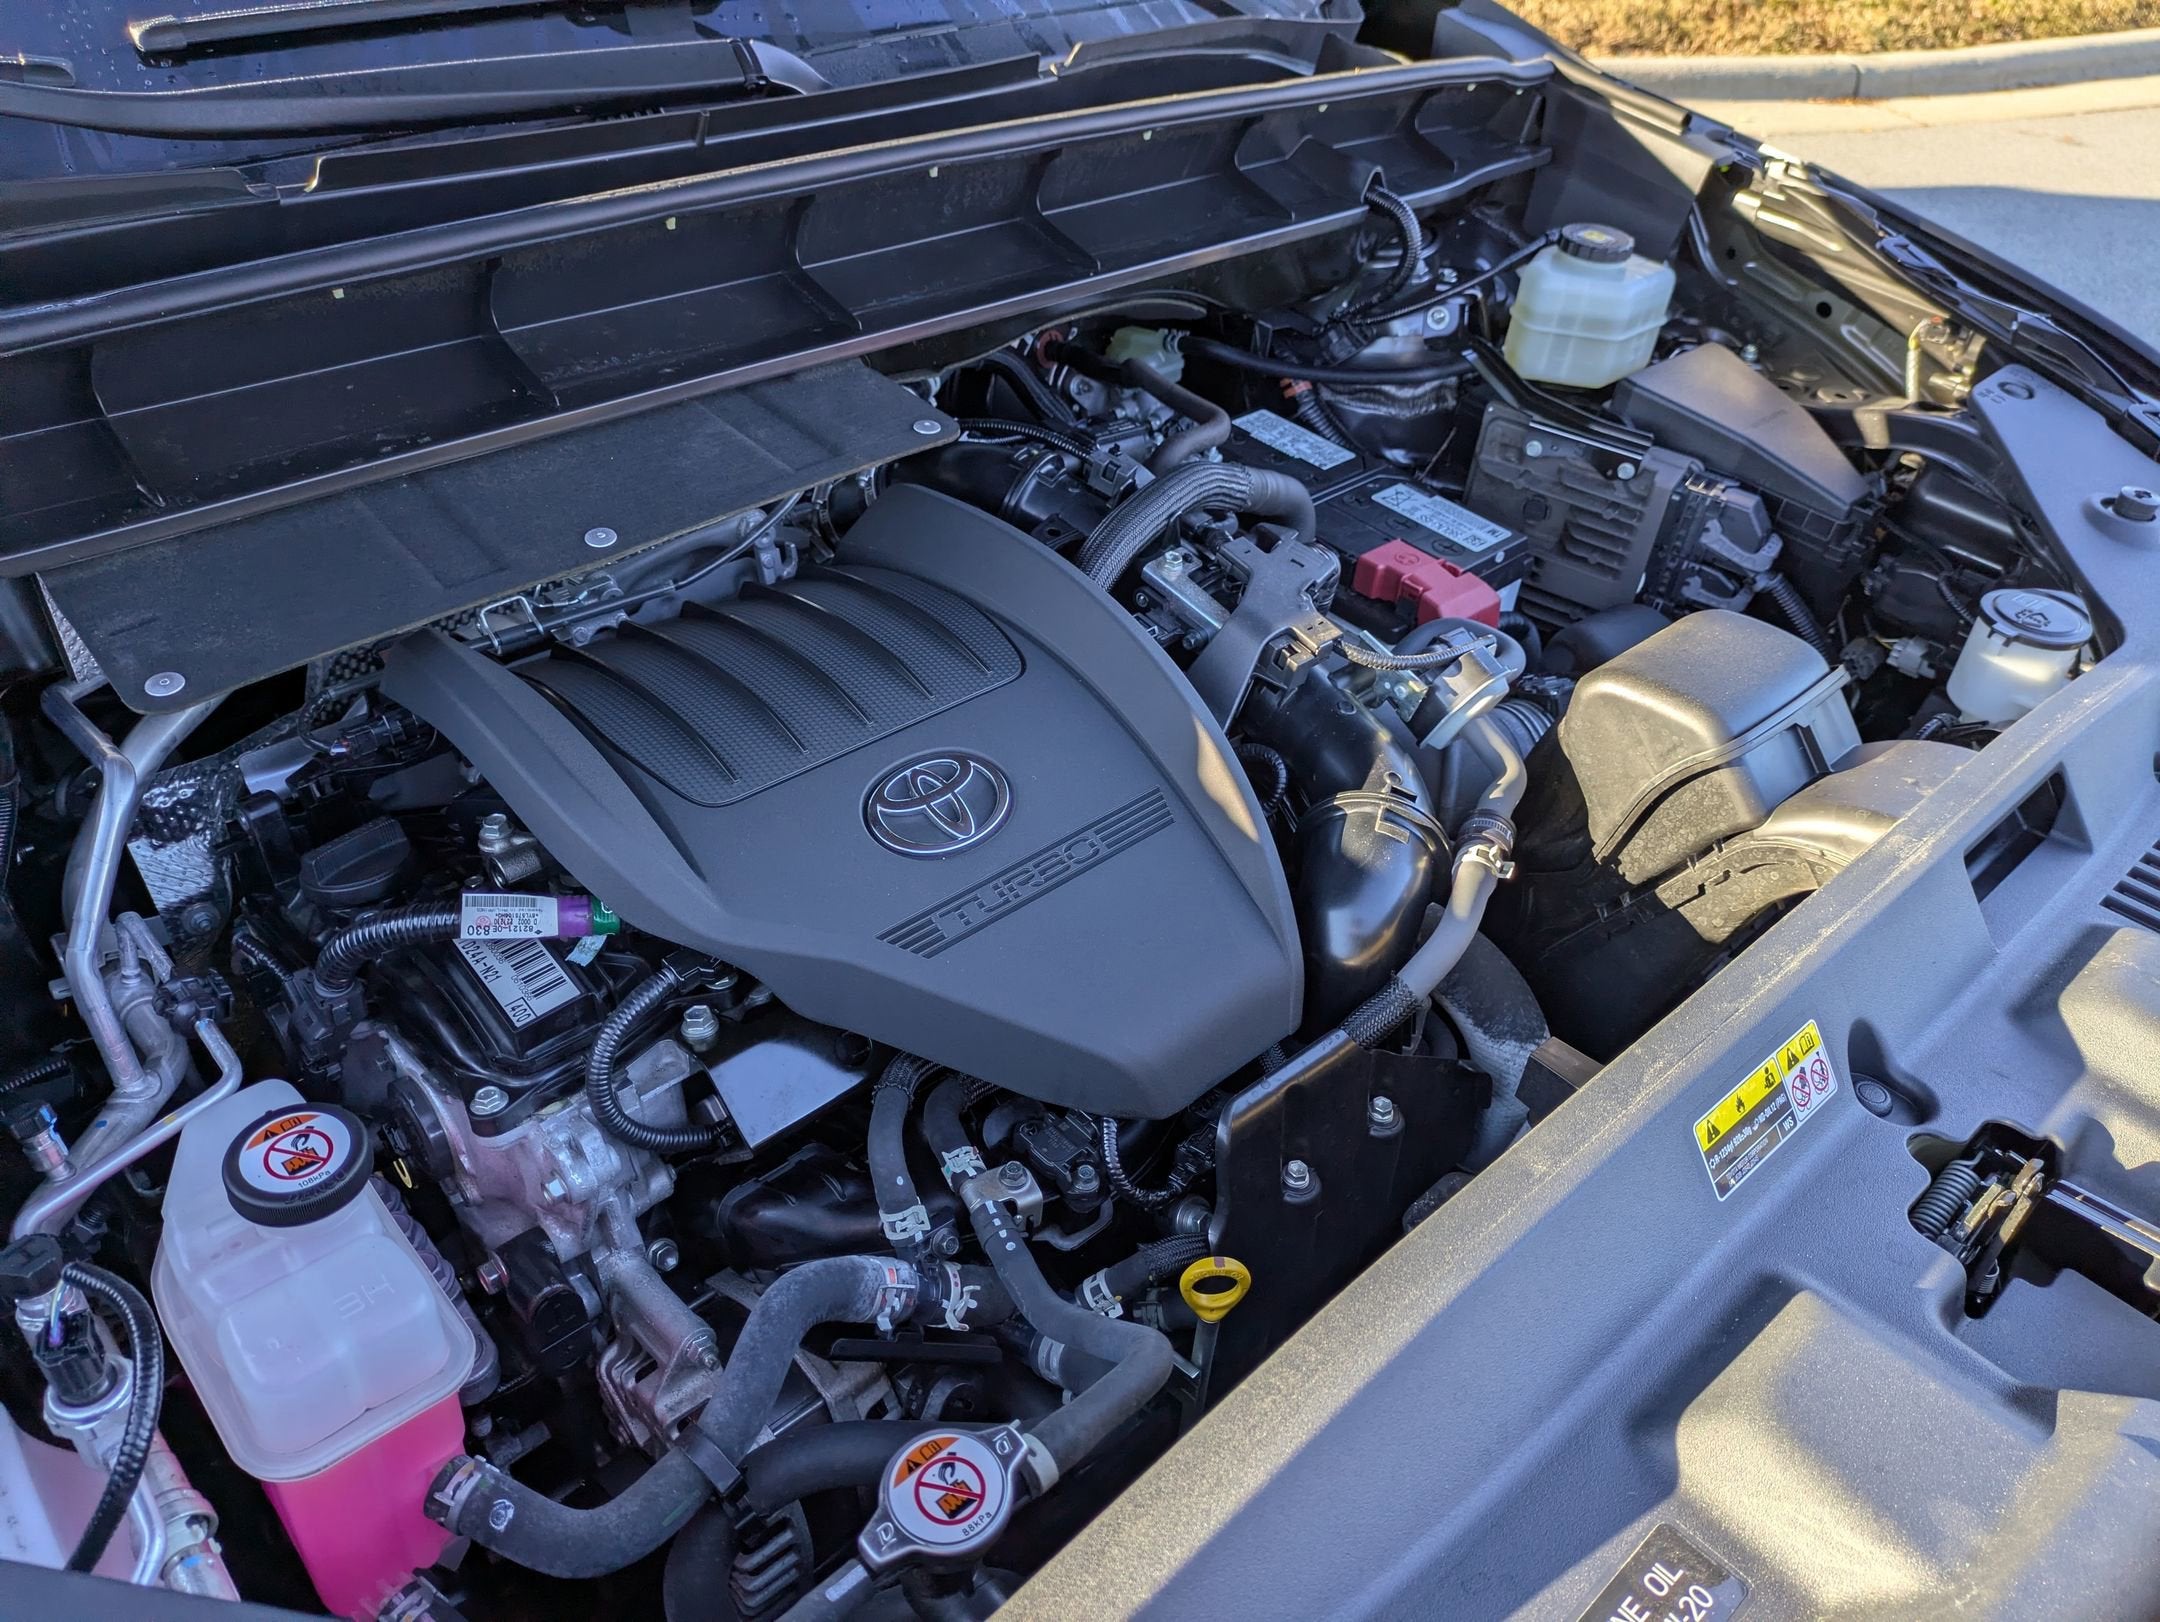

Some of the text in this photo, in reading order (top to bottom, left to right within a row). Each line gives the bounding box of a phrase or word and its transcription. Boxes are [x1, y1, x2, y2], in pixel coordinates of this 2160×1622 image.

[937, 836, 1100, 926] TURBO
[509, 1003, 532, 1023] 400
[1783, 1116, 1794, 1131] WS
[297, 1170, 331, 1188] 108kPa
[962, 1511, 993, 1537] 88kPa
[1644, 1563, 1684, 1597] OIL
